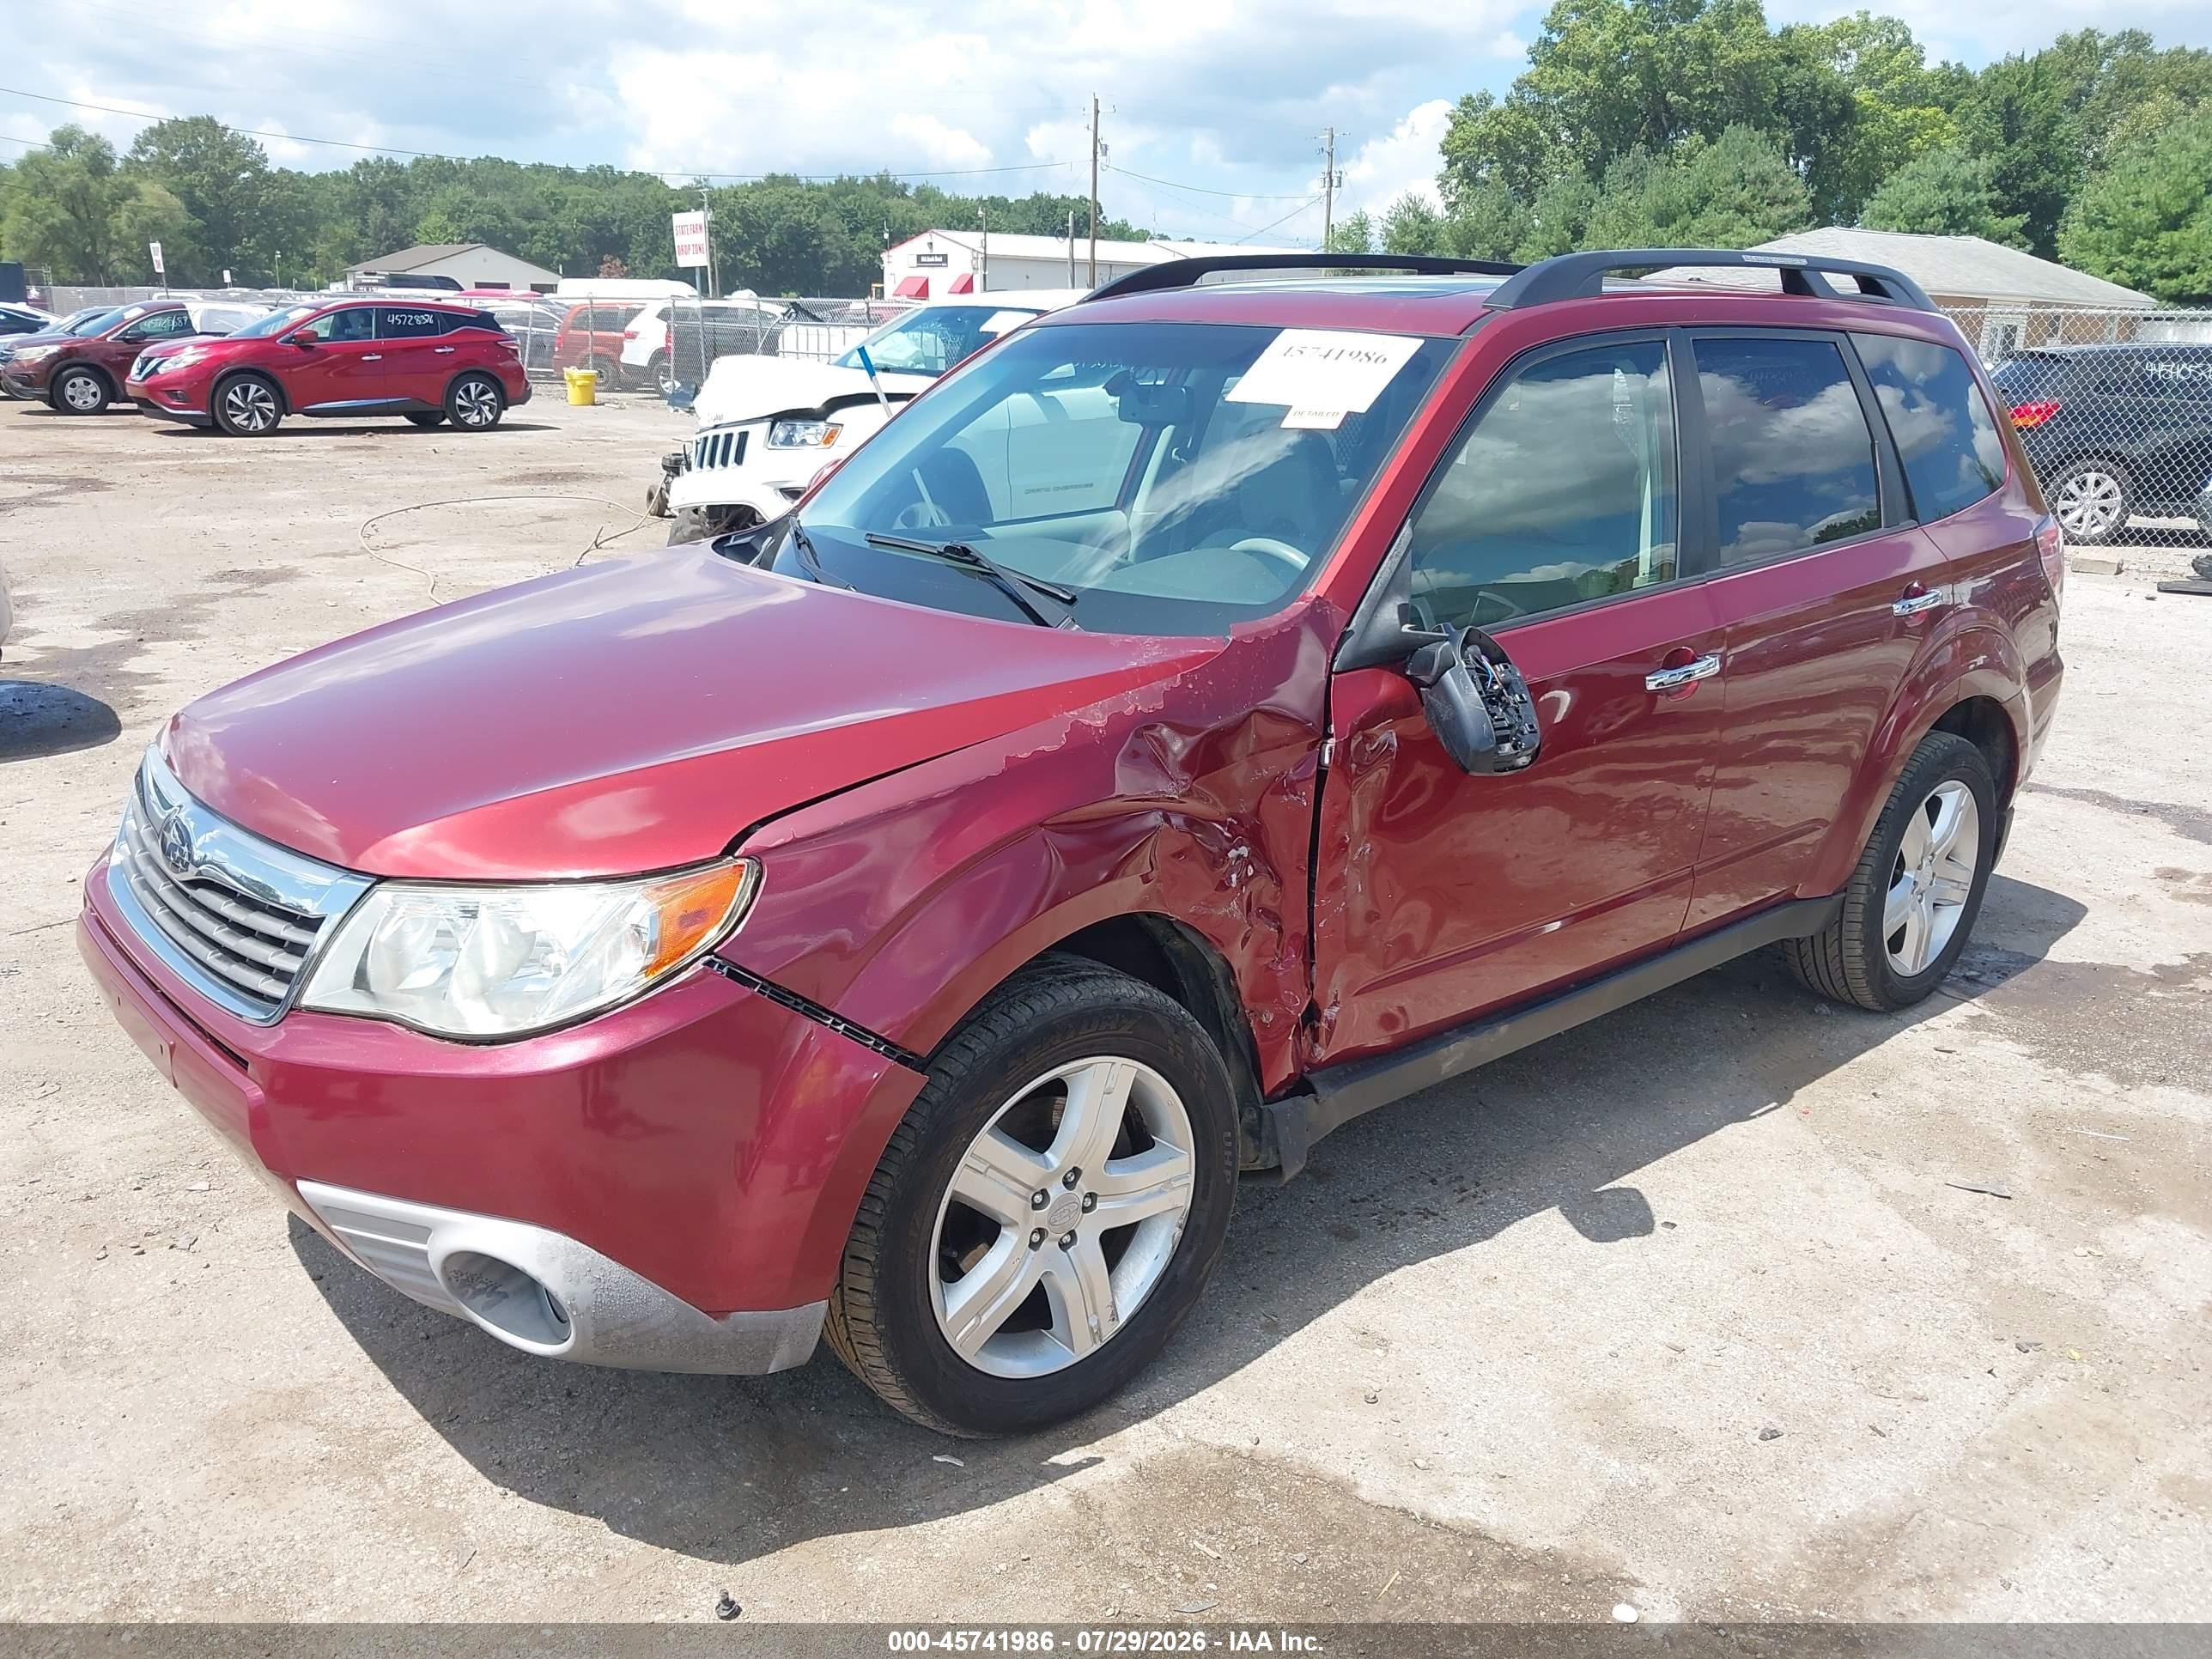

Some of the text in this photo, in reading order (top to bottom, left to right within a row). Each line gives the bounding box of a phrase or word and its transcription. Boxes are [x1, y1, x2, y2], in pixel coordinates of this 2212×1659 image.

[676, 224, 690, 235] STATE
[678, 243, 705, 256] DROP ZONE
